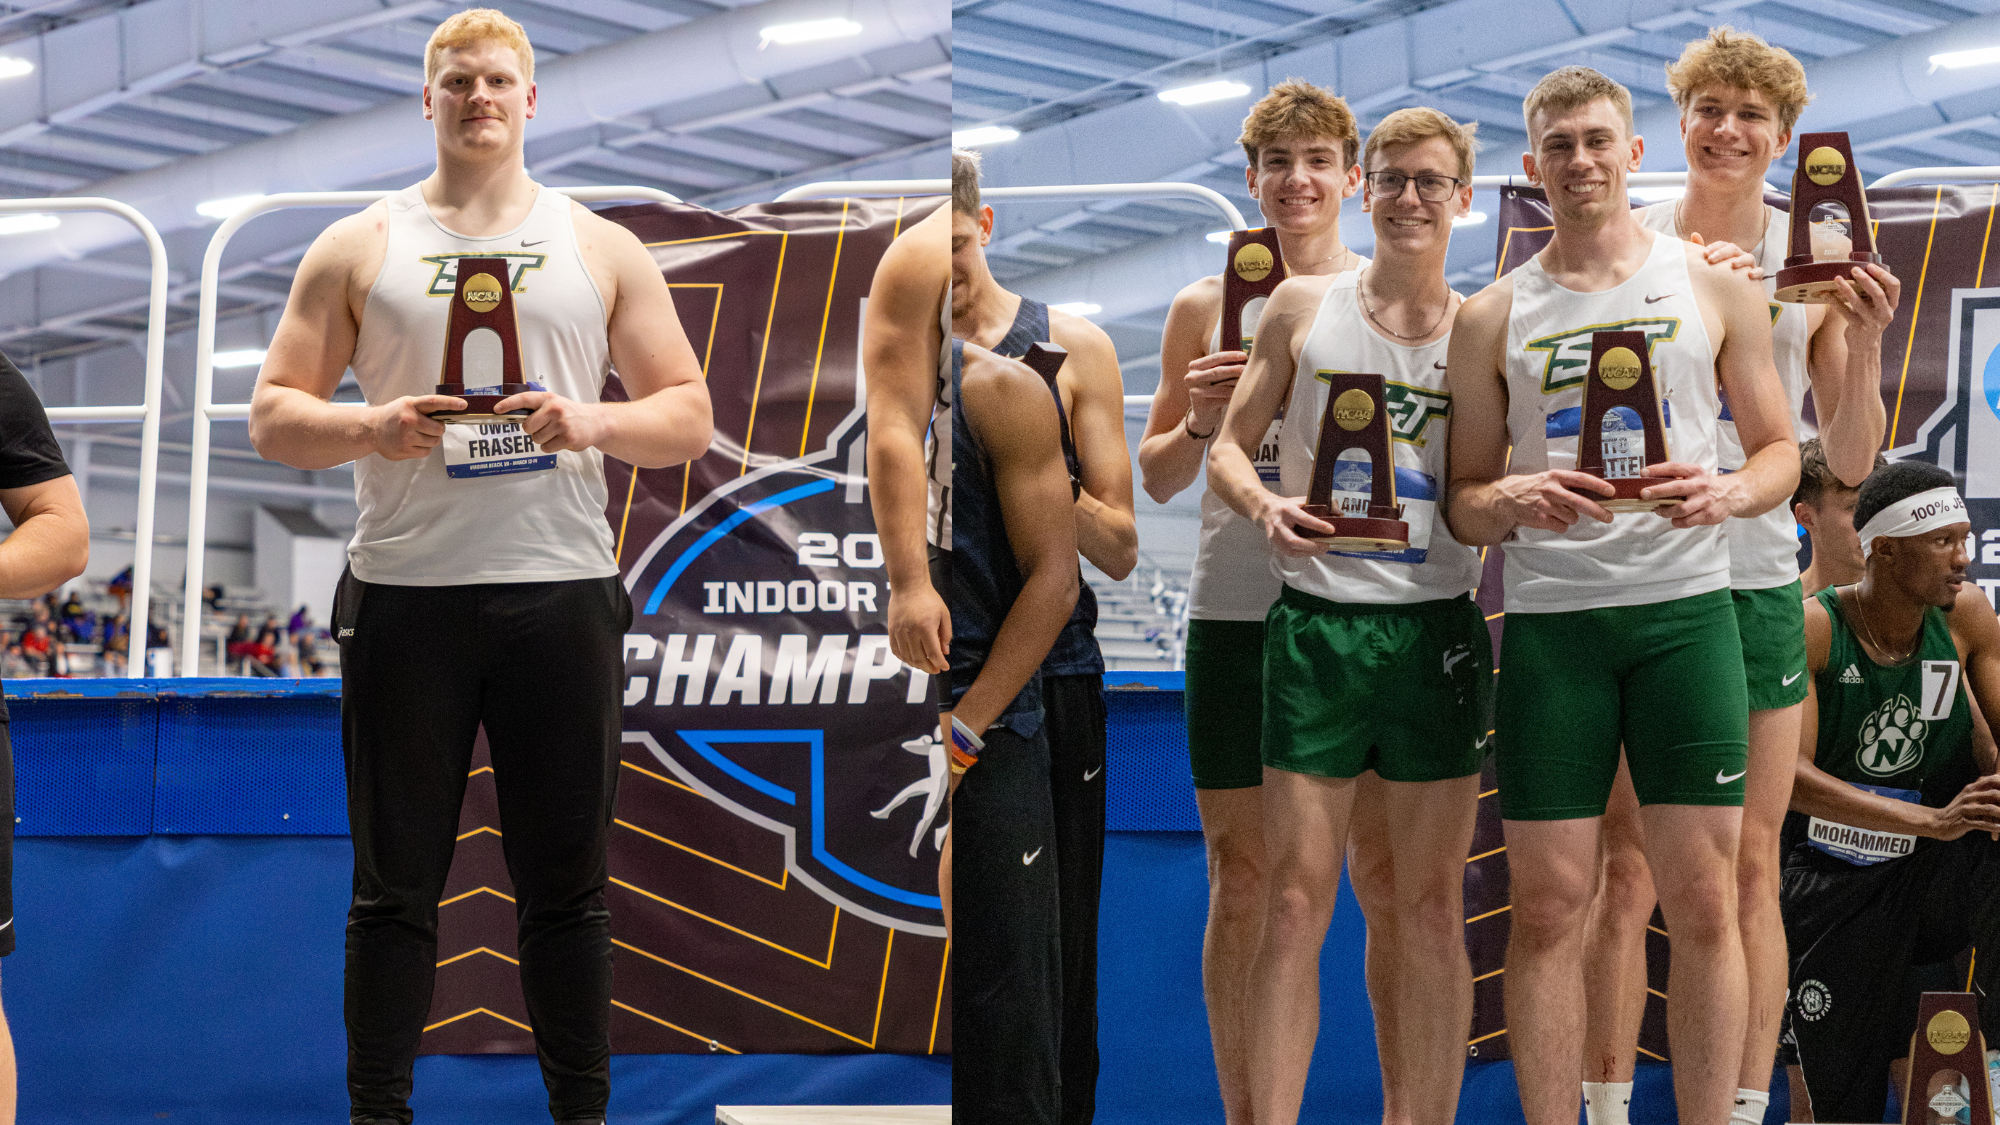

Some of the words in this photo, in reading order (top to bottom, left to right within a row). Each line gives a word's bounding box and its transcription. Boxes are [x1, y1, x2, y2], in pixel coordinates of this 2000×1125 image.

[1808, 164, 1844, 176] NCAA
[1236, 260, 1273, 273] NCAA
[466, 290, 500, 302] NCAA
[1603, 366, 1639, 379] NCAA
[1336, 408, 1373, 420] NCAA
[479, 422, 521, 436] OWEN
[468, 434, 535, 459] FRASER
[1911, 500, 1951, 522] 100%
[797, 532, 885, 569] 20
[703, 579, 878, 614] INDOOR
[1839, 676, 1865, 684] adidas
[1930, 664, 1953, 717] 7
[1869, 738, 1906, 768] N
[1813, 823, 1911, 855] MOHAMMED
[1930, 1031, 1969, 1044] NCAA
